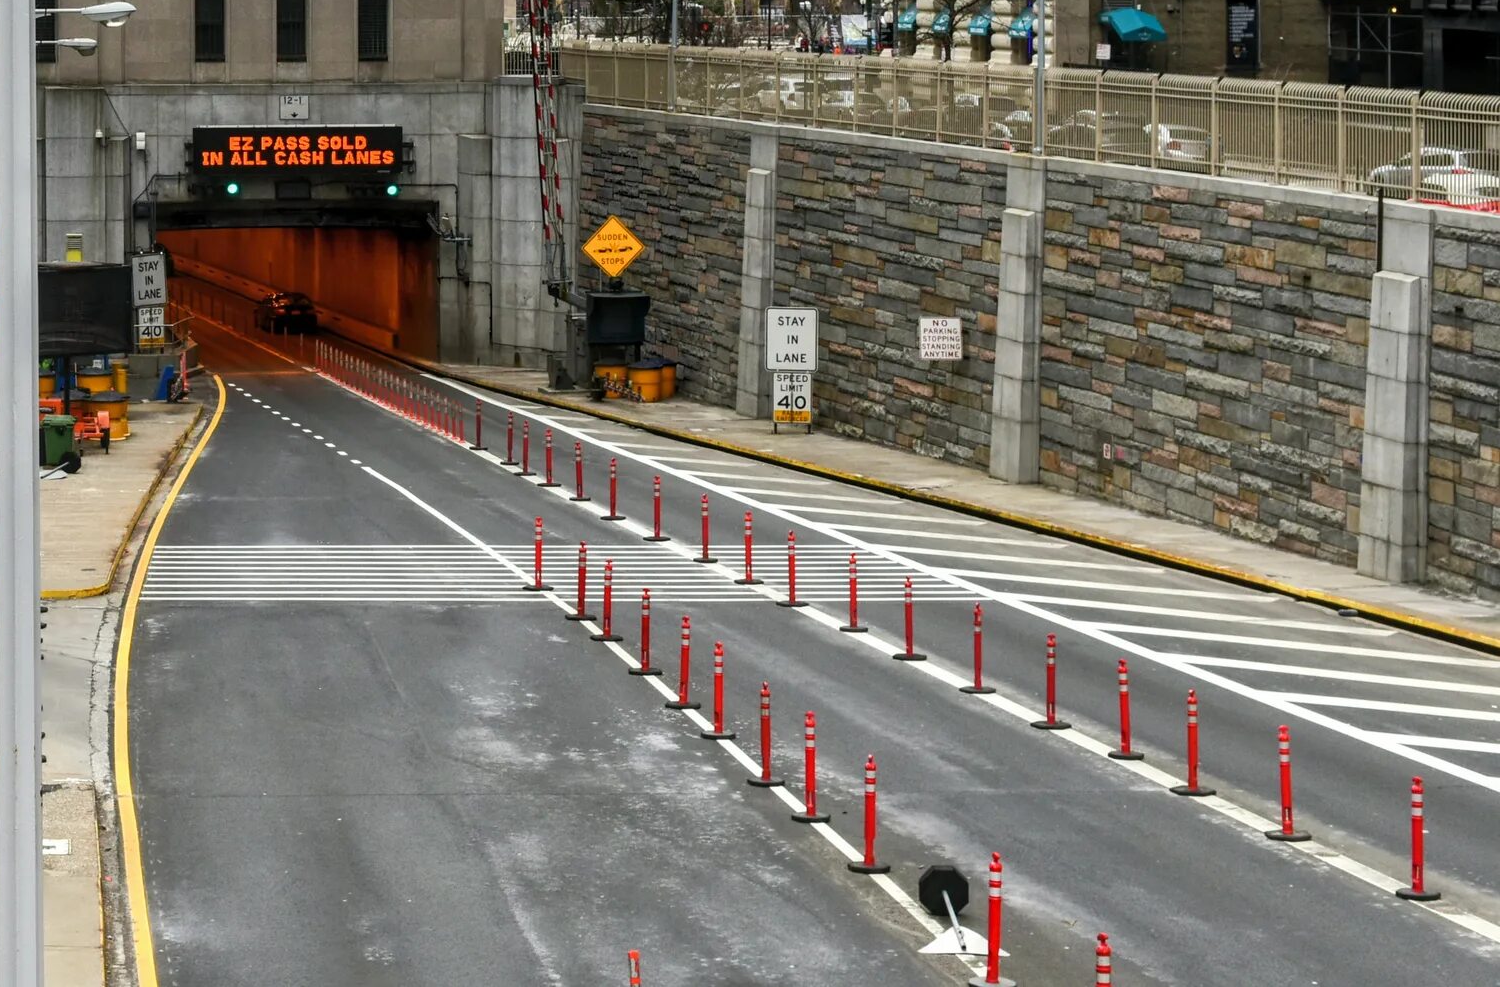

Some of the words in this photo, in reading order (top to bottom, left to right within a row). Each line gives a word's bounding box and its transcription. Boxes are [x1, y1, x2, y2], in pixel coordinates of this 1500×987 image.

[283, 96, 302, 105] 12-1
[229, 136, 254, 151] EZ
[261, 136, 310, 150] PASS
[318, 136, 367, 150] SOLD
[202, 152, 223, 166] IN
[231, 151, 267, 165] ALL
[275, 151, 324, 165] CASH
[331, 150, 395, 165] LANES
[597, 233, 628, 241] SUDDEN
[601, 257, 625, 265] STOPS
[138, 260, 159, 272] STAY
[145, 275, 154, 285] IN
[138, 288, 162, 300] LANE
[140, 308, 163, 316] SPEED
[778, 316, 806, 327] STAY
[932, 319, 948, 327] NO
[141, 326, 162, 338] 40
[923, 327, 958, 335] PARKING
[787, 334, 799, 345] IN
[922, 335, 961, 343] STOPPING
[775, 352, 807, 364] LANE
[924, 350, 960, 358] ANYTIME
[776, 374, 809, 383] SPEED
[780, 384, 804, 392] LIMIT
[777, 395, 807, 410] 40
